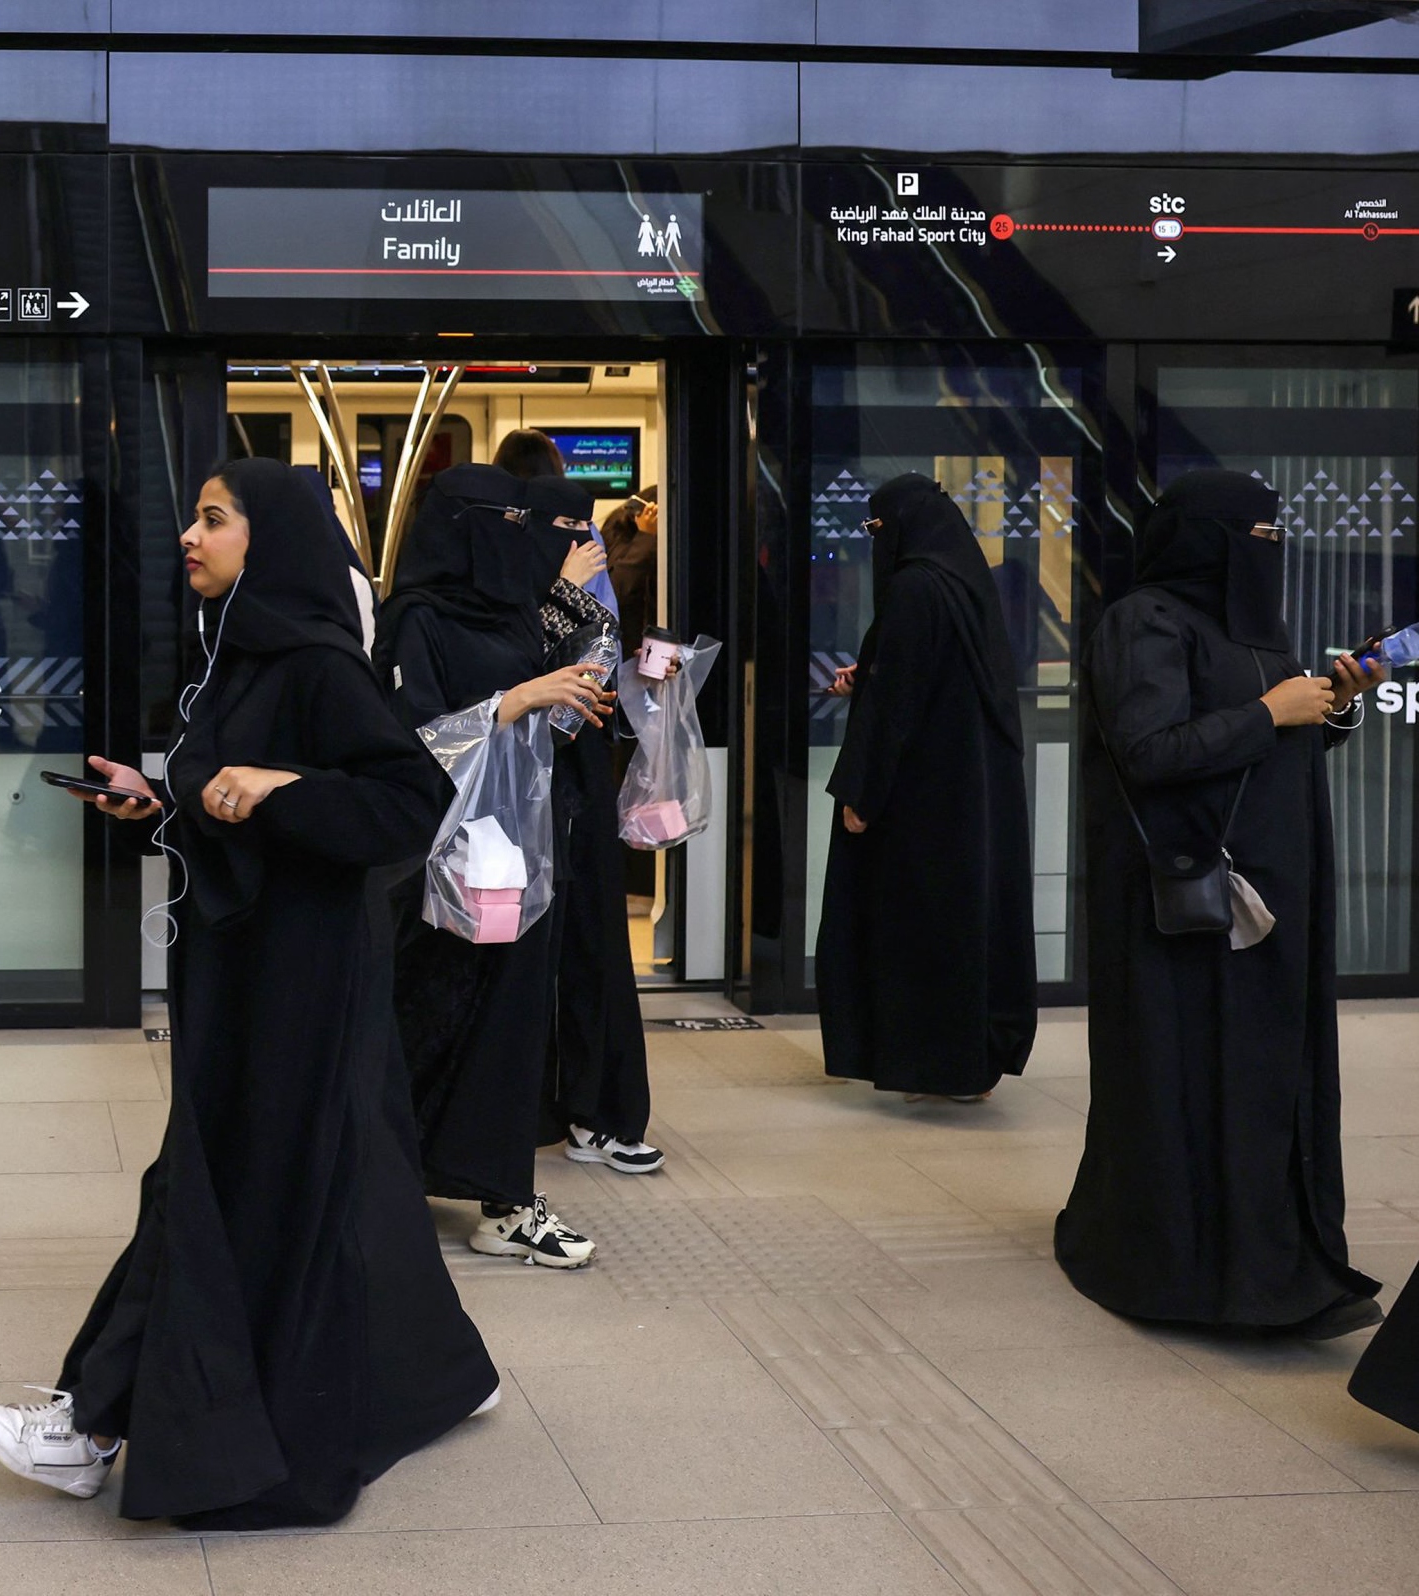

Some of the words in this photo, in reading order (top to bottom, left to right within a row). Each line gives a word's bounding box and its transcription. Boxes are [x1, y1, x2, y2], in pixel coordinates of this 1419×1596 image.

[901, 175, 914, 193] P
[381, 199, 461, 223] العائلات
[1149, 193, 1186, 214] stc
[830, 205, 877, 224] الرياضية
[881, 207, 909, 221] فهد
[912, 206, 946, 221] الملك
[950, 207, 986, 225] مدينة
[1344, 209, 1353, 219] Al
[1353, 209, 1399, 219] Takhassussi
[995, 221, 1009, 233] 25
[1158, 225, 1166, 234] 15
[837, 227, 869, 246] King
[872, 227, 914, 242] Fahad
[918, 227, 956, 246] Sport
[959, 227, 986, 246] City
[383, 236, 461, 267] Family
